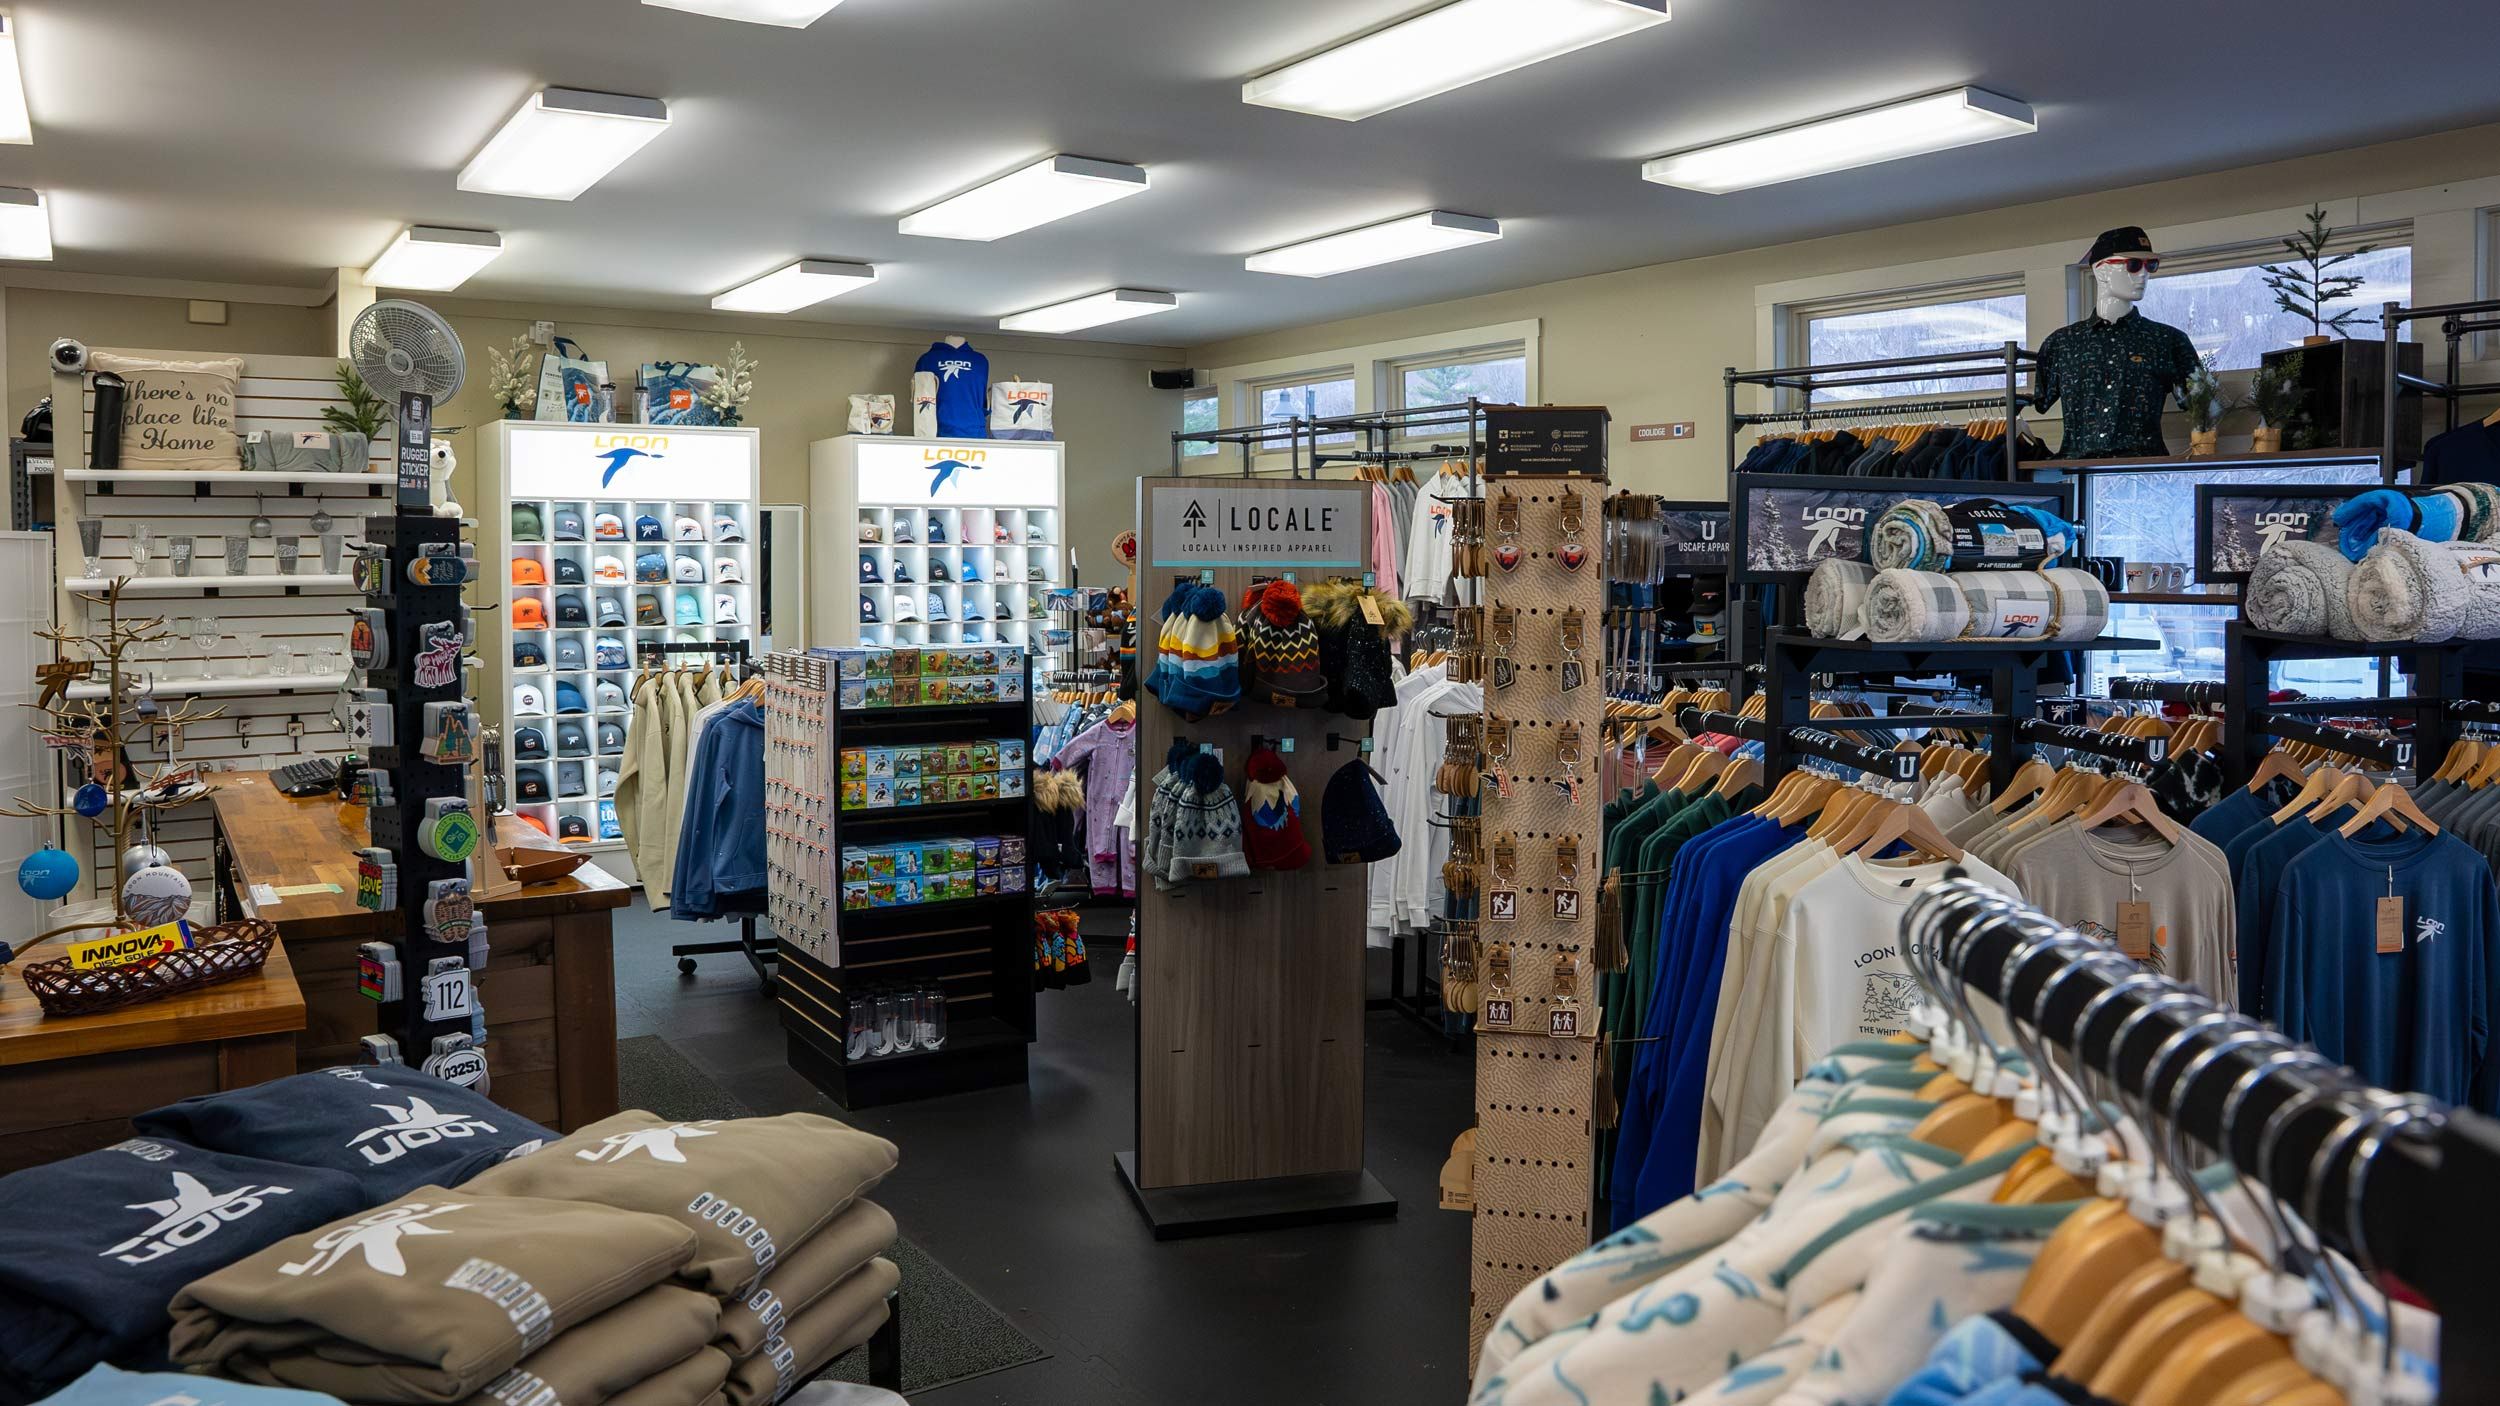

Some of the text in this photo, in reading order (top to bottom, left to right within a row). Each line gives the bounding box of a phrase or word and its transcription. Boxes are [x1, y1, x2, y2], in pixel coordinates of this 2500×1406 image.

[937, 360, 972, 368] LOON
[124, 379, 230, 407] There's no
[1007, 390, 1049, 400] LOON
[121, 404, 228, 434] place like
[140, 426, 216, 451] Home
[1638, 427, 1666, 437] COOLIDGE
[593, 435, 669, 449] LOON
[401, 446, 428, 461] RUGGED
[923, 448, 987, 462] LOON
[400, 462, 429, 476] STICKER
[1230, 506, 1333, 532] LOCALE
[1802, 506, 1868, 522] LOON
[1969, 509, 2007, 519] LOCALE
[2254, 511, 2310, 526] LOON
[1182, 543, 1333, 553] LOCALLY INSPIRED APPAREL
[1678, 542, 1706, 553] USCAPE
[2003, 614, 2039, 624] LOON
[1566, 775, 1580, 804] LOON
[145, 871, 185, 889] MOUNTAIN
[81, 934, 163, 964] INNOVA
[1854, 945, 1896, 968] LOON
[93, 957, 123, 969] DISC
[437, 979, 466, 1012] 112
[1859, 1025, 1875, 1034] THE
[358, 1120, 499, 1165] LOON
[116, 1186, 294, 1264] LOON
